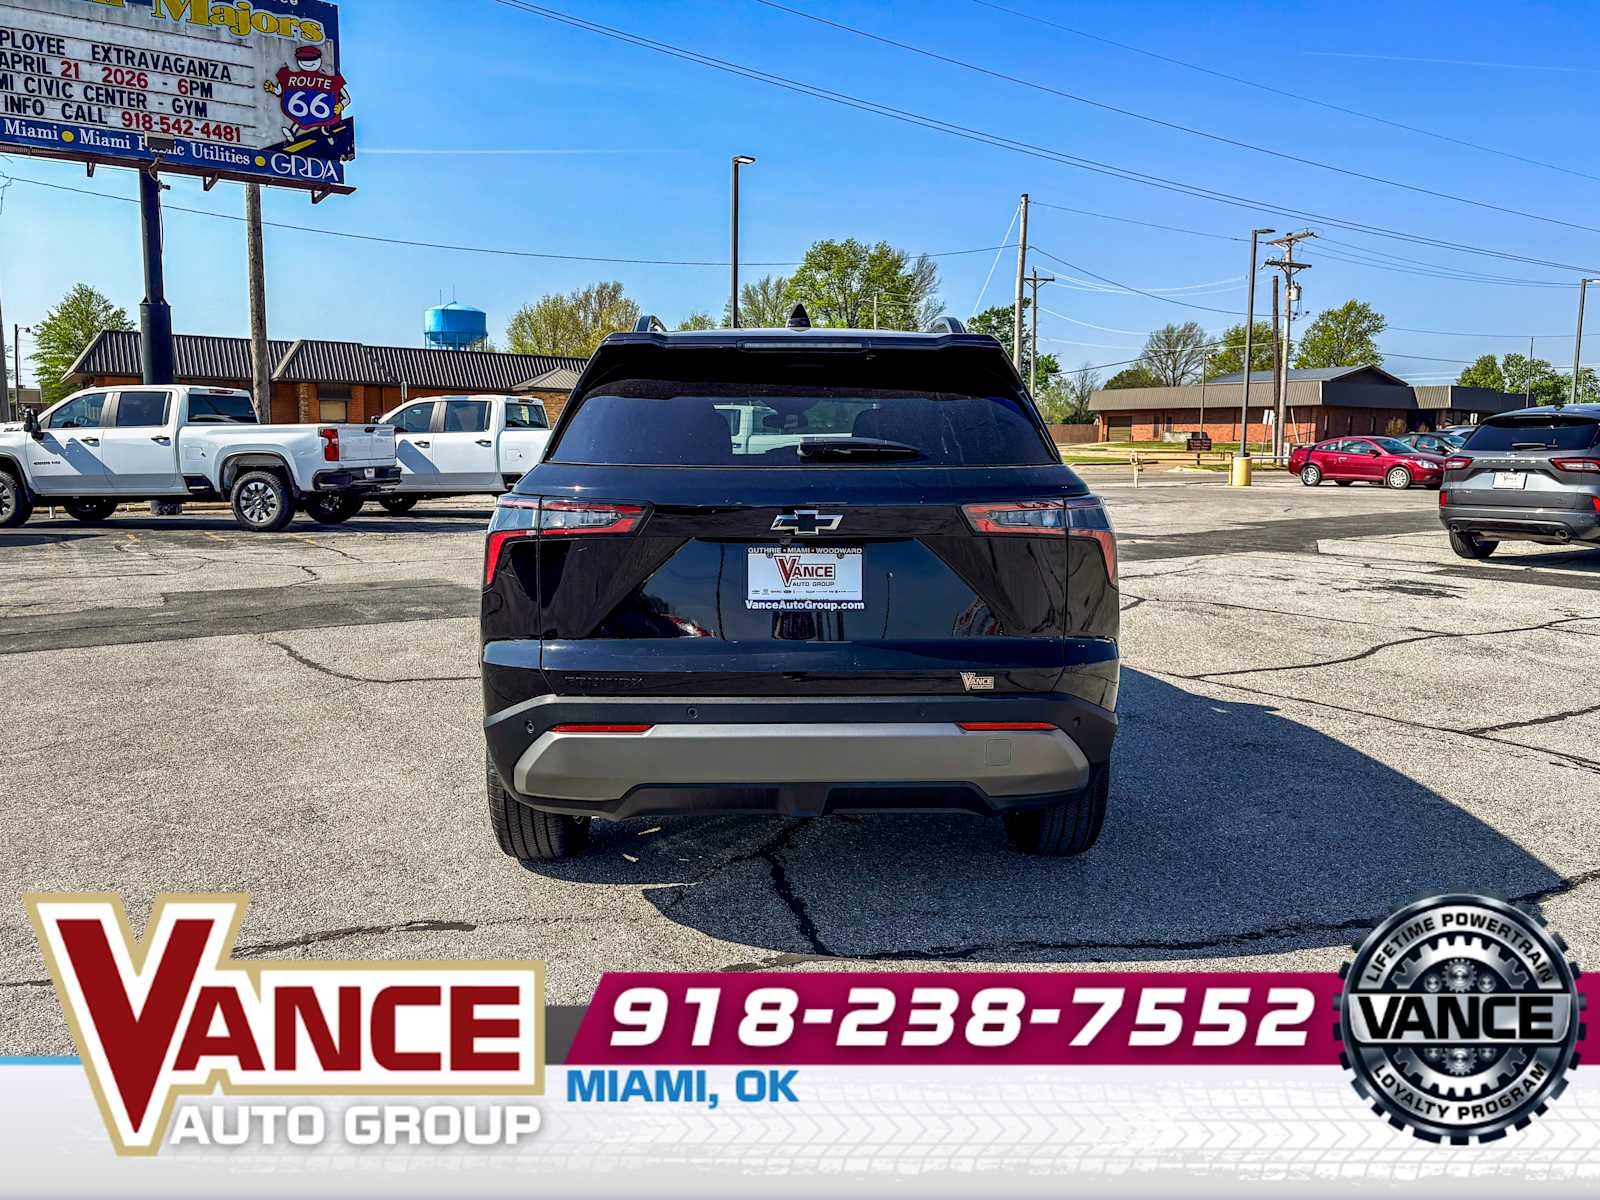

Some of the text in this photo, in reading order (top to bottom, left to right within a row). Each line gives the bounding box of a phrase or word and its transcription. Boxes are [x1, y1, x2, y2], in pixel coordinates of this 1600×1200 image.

[151, 0, 326, 43] Majors
[0, 54, 52, 75] APRIL
[60, 61, 79, 79] 21
[101, 66, 149, 89] 2026
[178, 78, 213, 98] 6PM
[91, 44, 232, 81] EXTRAVAGANZA
[288, 76, 332, 89] ROUTE
[24, 77, 74, 98] CIVIC
[83, 85, 147, 109] CENTER
[172, 97, 208, 118] GYM
[287, 91, 330, 119] 66
[4, 94, 241, 143] INFO CALL 918-542-4481
[4, 118, 59, 140] Miami
[79, 128, 131, 150] Miami
[190, 142, 251, 165] Utilities
[270, 153, 339, 182] GRDA
[745, 600, 865, 611] VanceAutoGroup.com
